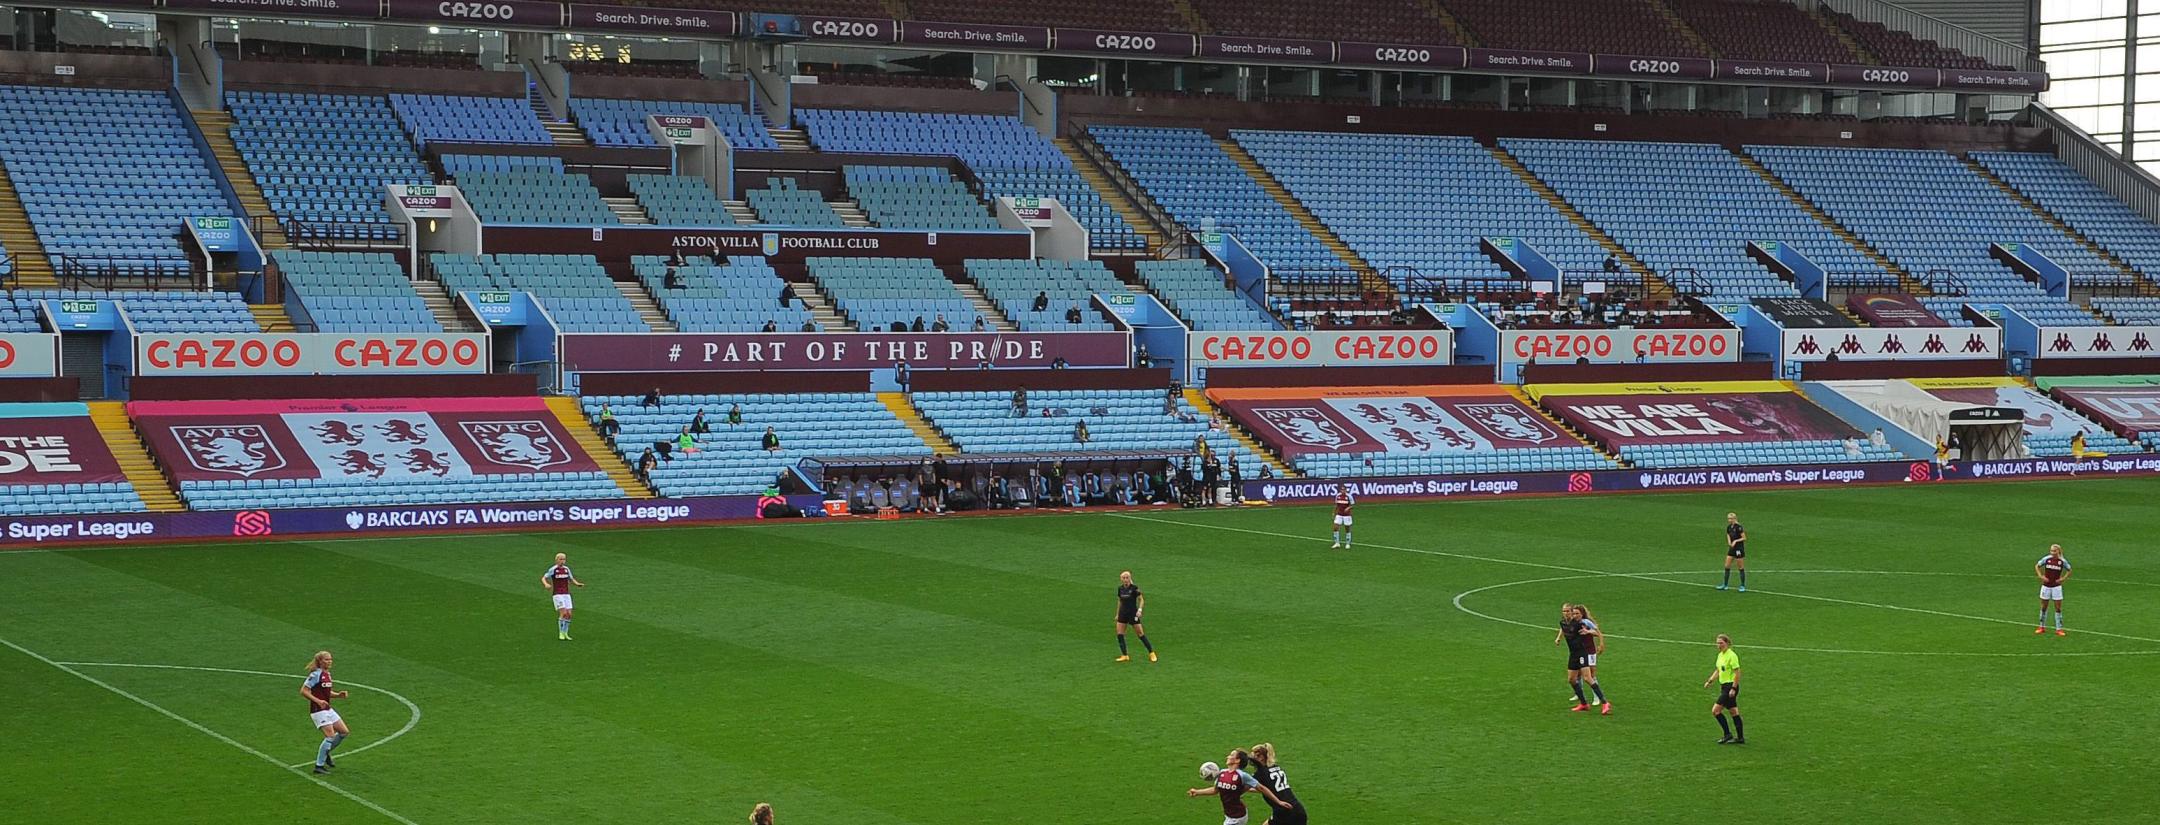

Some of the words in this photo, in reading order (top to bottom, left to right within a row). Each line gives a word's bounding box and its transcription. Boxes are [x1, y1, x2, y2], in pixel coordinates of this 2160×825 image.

[439, 2, 513, 19] CAZOO
[595, 12, 637, 24] Search.
[640, 14, 672, 26] Drive.
[675, 16, 709, 28] Smile.
[812, 21, 879, 37] CAZOO
[925, 28, 963, 40] Search.
[965, 31, 994, 41] Drive.
[996, 32, 1028, 43] Smile.
[1095, 34, 1156, 50] CAZOO
[1221, 43, 1255, 53] Search.
[1257, 44, 1284, 54] Drive.
[1285, 46, 1313, 56] Smile.
[1375, 48, 1430, 62] CAZOO
[1489, 55, 1519, 65] Search.
[1521, 56, 1546, 66] Drive.
[1547, 57, 1573, 67] Smile.
[1629, 60, 1679, 74] CAZOO
[1734, 66, 1762, 75] Search.
[1764, 67, 1787, 76] Drive.
[1788, 68, 1812, 77] Smile.
[1863, 69, 1909, 82] CAZOO
[1958, 75, 1984, 84] Search.
[1986, 76, 2007, 85] Drive.
[2008, 77, 2030, 86] Smile.
[406, 197, 437, 205] CAZOO
[213, 219, 228, 227] EXIT
[198, 231, 230, 239] CAZOO
[672, 236, 717, 247] ASTON
[720, 236, 759, 247] VILLA
[782, 237, 845, 248] FOOTBALL
[847, 237, 879, 249] CLUB
[495, 294, 509, 302] EXIT
[79, 303, 96, 311] EXIT
[147, 339, 301, 368] CAZOO
[334, 338, 479, 367] CAZOO
[668, 343, 682, 362] #
[703, 341, 786, 362] PART
[806, 341, 846, 362] OF
[864, 341, 928, 361] THE
[1202, 335, 1311, 361] CAZOO
[1334, 335, 1439, 360] CAZOO
[1513, 334, 1612, 358] CAZOO
[1632, 334, 1727, 358] CAZOO
[1265, 410, 1319, 418] AVFC
[1468, 405, 1517, 414] AVFC
[1568, 405, 1637, 419] WE
[1638, 404, 1711, 418] ARE
[2082, 397, 2160, 419] UT
[184, 428, 259, 438] AVFC
[473, 423, 539, 434] AVFC
[1589, 417, 1744, 437] VILLA
[0, 436, 69, 449] THE
[1984, 462, 2032, 475] BARCLAYS
[2036, 461, 2049, 473] FA
[2102, 459, 2134, 473] Super
[1653, 472, 1707, 486] BARCLAYS
[1710, 472, 1726, 484] FA
[1784, 470, 1820, 484] Super
[1822, 468, 1865, 483] League
[1278, 483, 1338, 498] BARCLAYS
[1343, 483, 1360, 496] FA
[1427, 480, 1467, 496] Super
[1470, 479, 1518, 494] League
[367, 510, 449, 527] BARCLAYS
[455, 509, 478, 524] FA
[569, 506, 622, 524] Super
[626, 505, 690, 522] League
[8, 522, 73, 541] Super
[78, 520, 154, 539] League
[1269, 770, 1290, 792] 22
